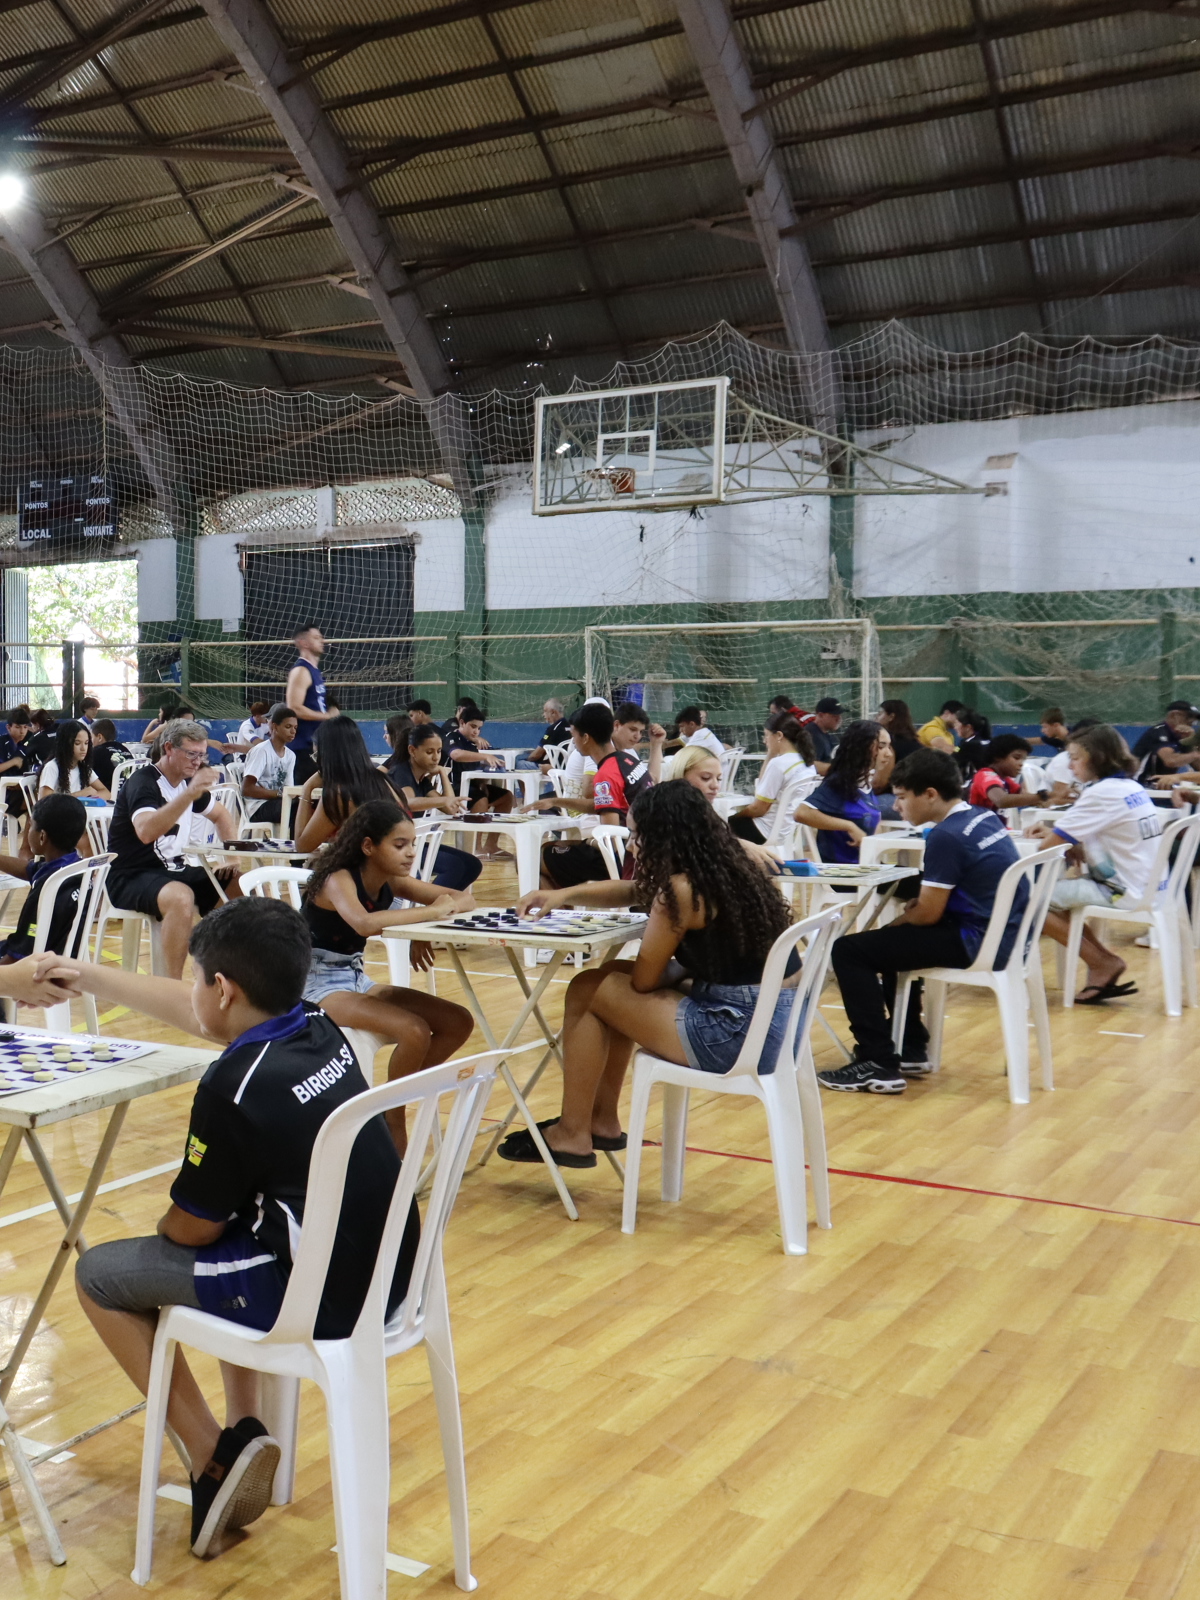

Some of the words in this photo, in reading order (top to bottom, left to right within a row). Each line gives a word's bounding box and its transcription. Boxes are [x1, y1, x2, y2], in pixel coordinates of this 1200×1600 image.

[24, 502, 49, 510] PONTOS
[85, 497, 110, 506] PONTOS
[22, 528, 52, 539] LOCAL
[83, 525, 114, 537] VISITANTE
